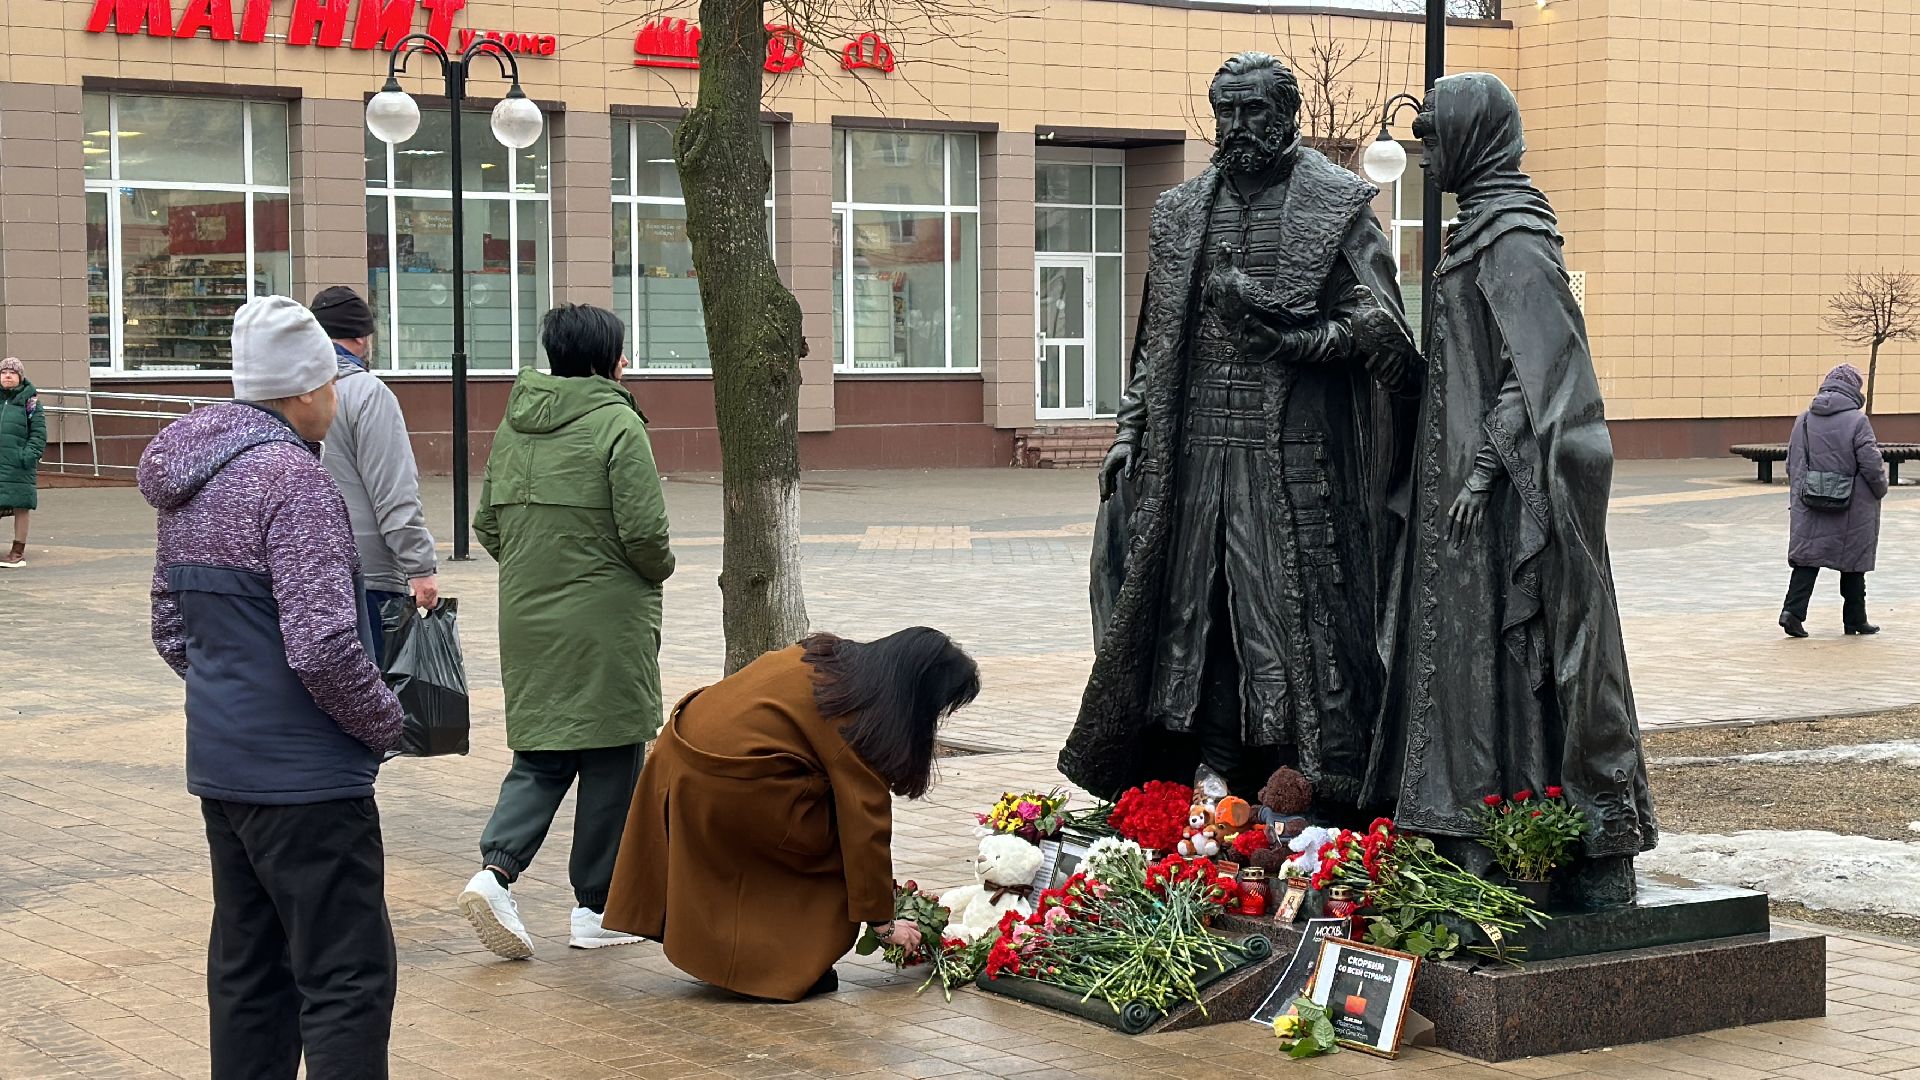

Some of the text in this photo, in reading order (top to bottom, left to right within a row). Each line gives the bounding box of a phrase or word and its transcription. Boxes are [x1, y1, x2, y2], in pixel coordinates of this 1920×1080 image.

[86, 0, 466, 54] МАГНИТ
[1338, 964, 1392, 983] СО ВСЕЙ СТРАНОЙ
[1347, 956, 1384, 972] СКОРБИМ
